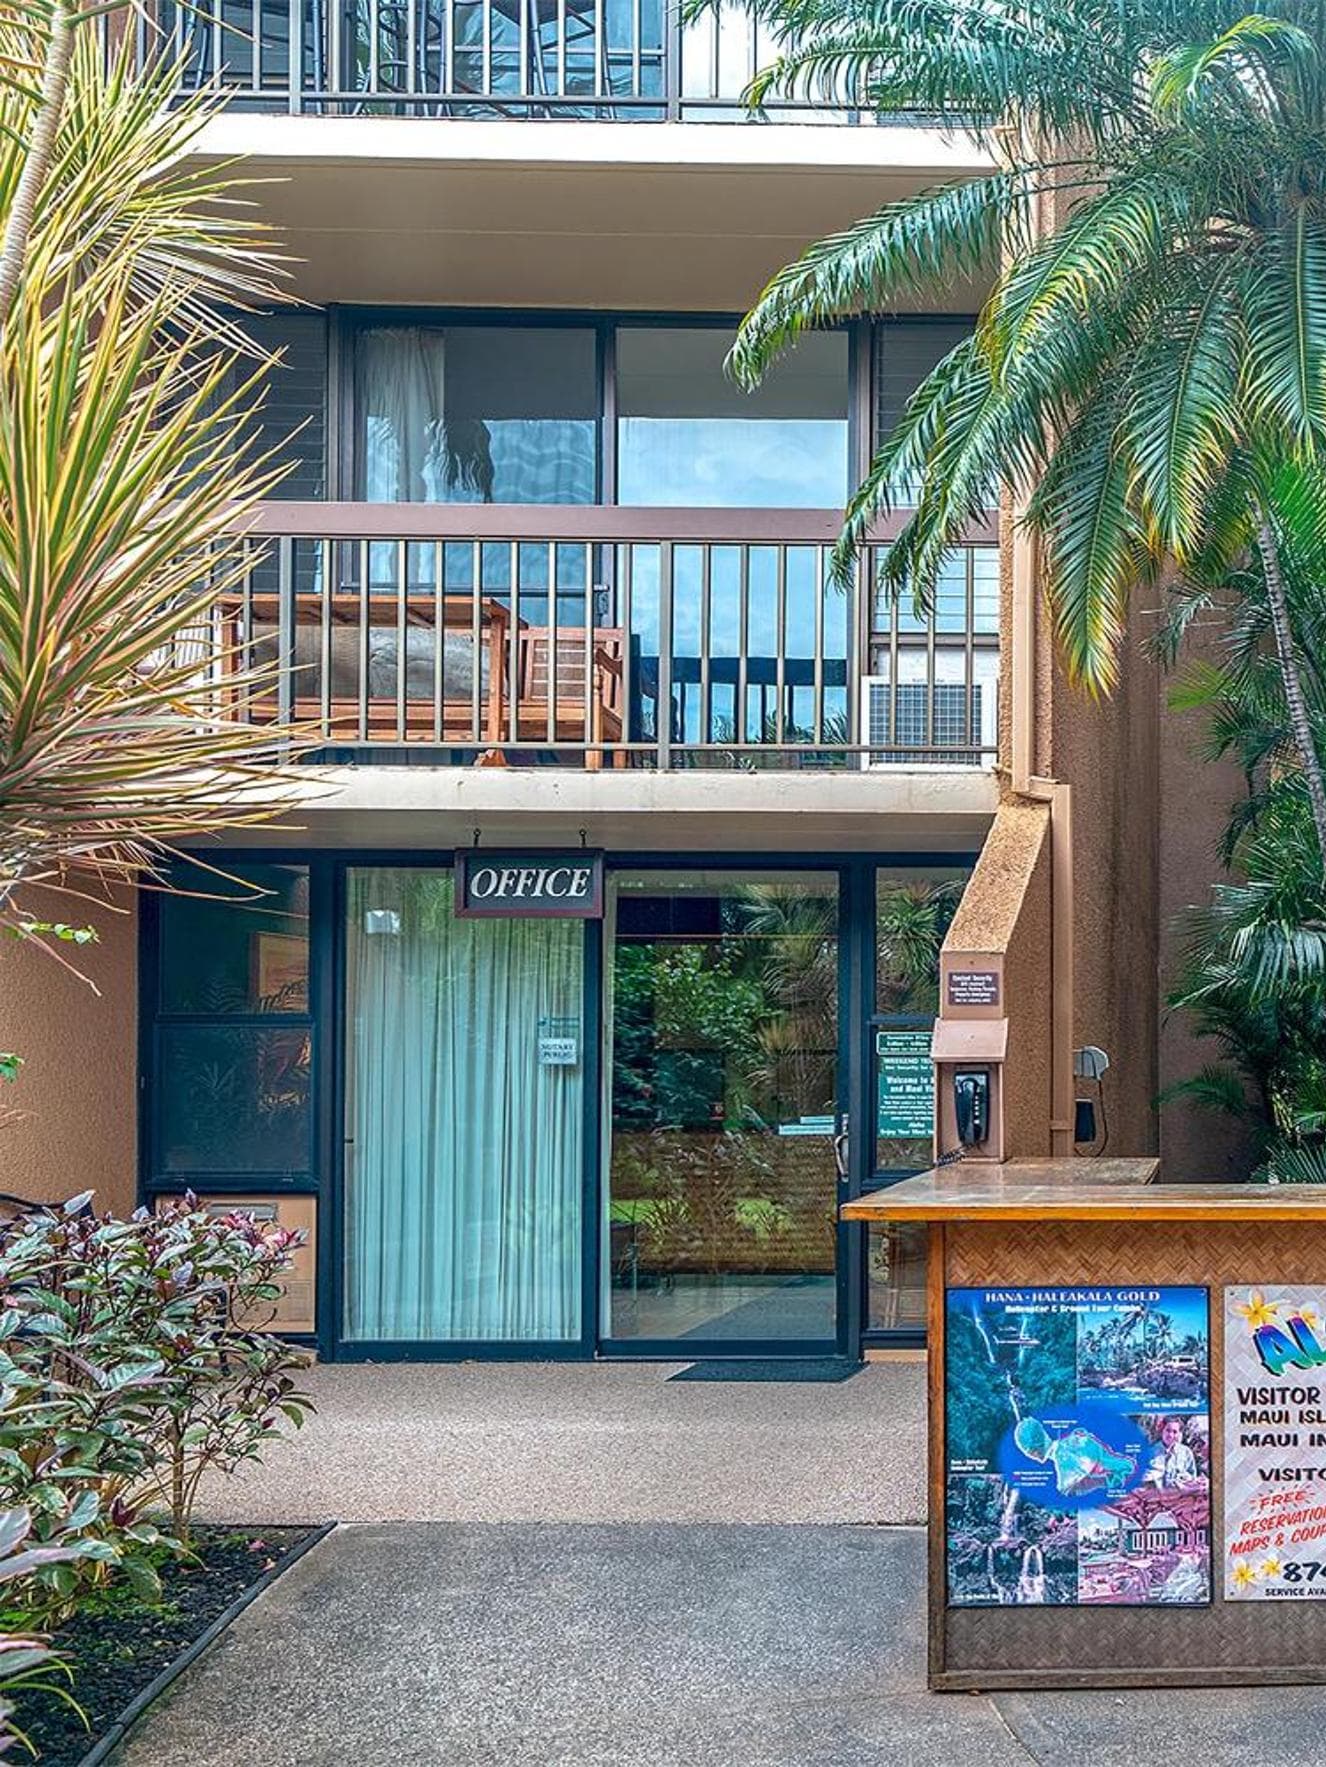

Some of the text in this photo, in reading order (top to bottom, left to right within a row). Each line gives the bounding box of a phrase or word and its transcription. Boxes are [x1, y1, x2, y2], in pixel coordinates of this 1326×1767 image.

[470, 868, 591, 898] OFFICE
[985, 1291, 1161, 1303] HANA HALEAKALA GOLD
[1236, 1386, 1321, 1405] VISITOR
[1240, 1410, 1290, 1424] MAUI
[1240, 1432, 1299, 1447] MAUI
[1259, 1489, 1308, 1510] FREE
[1229, 1535, 1271, 1557] MAPS
[1274, 1532, 1285, 1546] &
[1265, 1588, 1305, 1597] SERVICE
